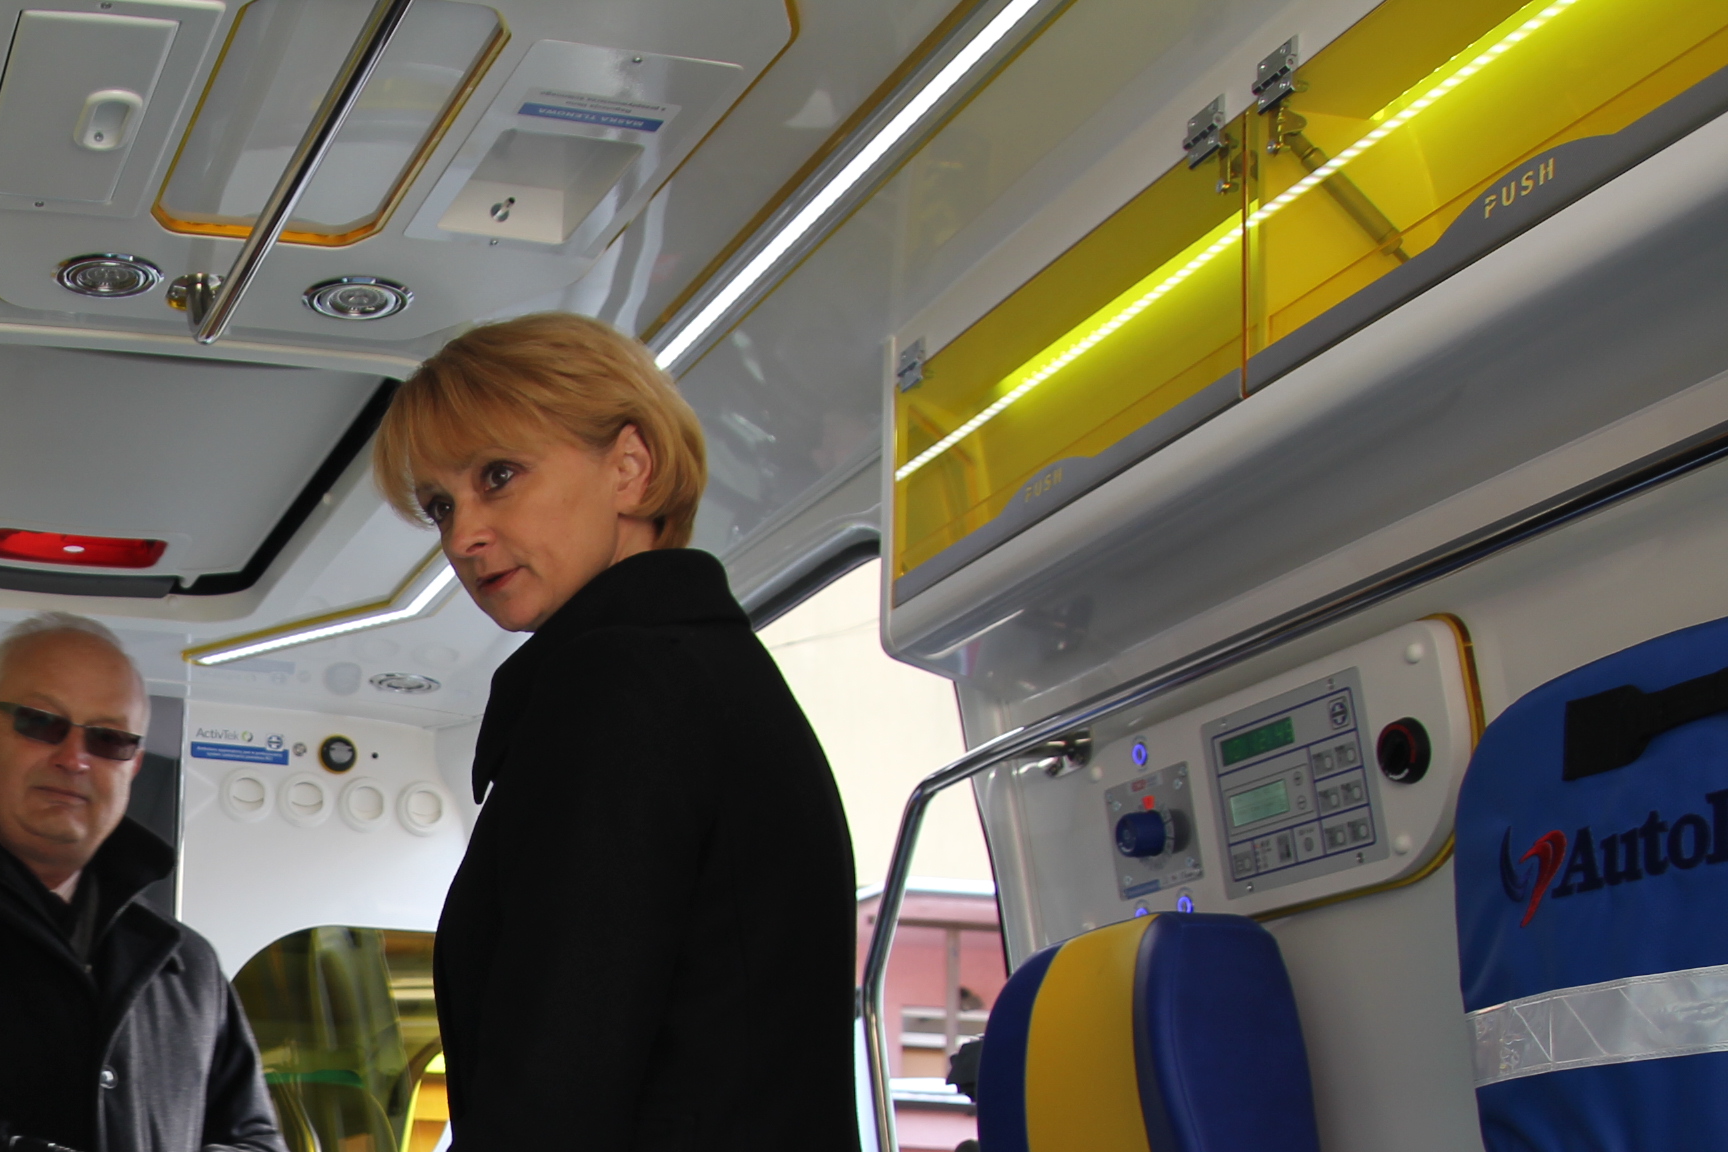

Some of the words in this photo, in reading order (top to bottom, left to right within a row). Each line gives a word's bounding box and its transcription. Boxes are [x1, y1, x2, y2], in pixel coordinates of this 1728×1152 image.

[538, 107, 597, 120] TLENOWA
[601, 116, 644, 127] MASKA
[1484, 157, 1555, 219] PUSH
[1025, 467, 1063, 503] PUSH
[196, 727, 239, 740] ActivTek
